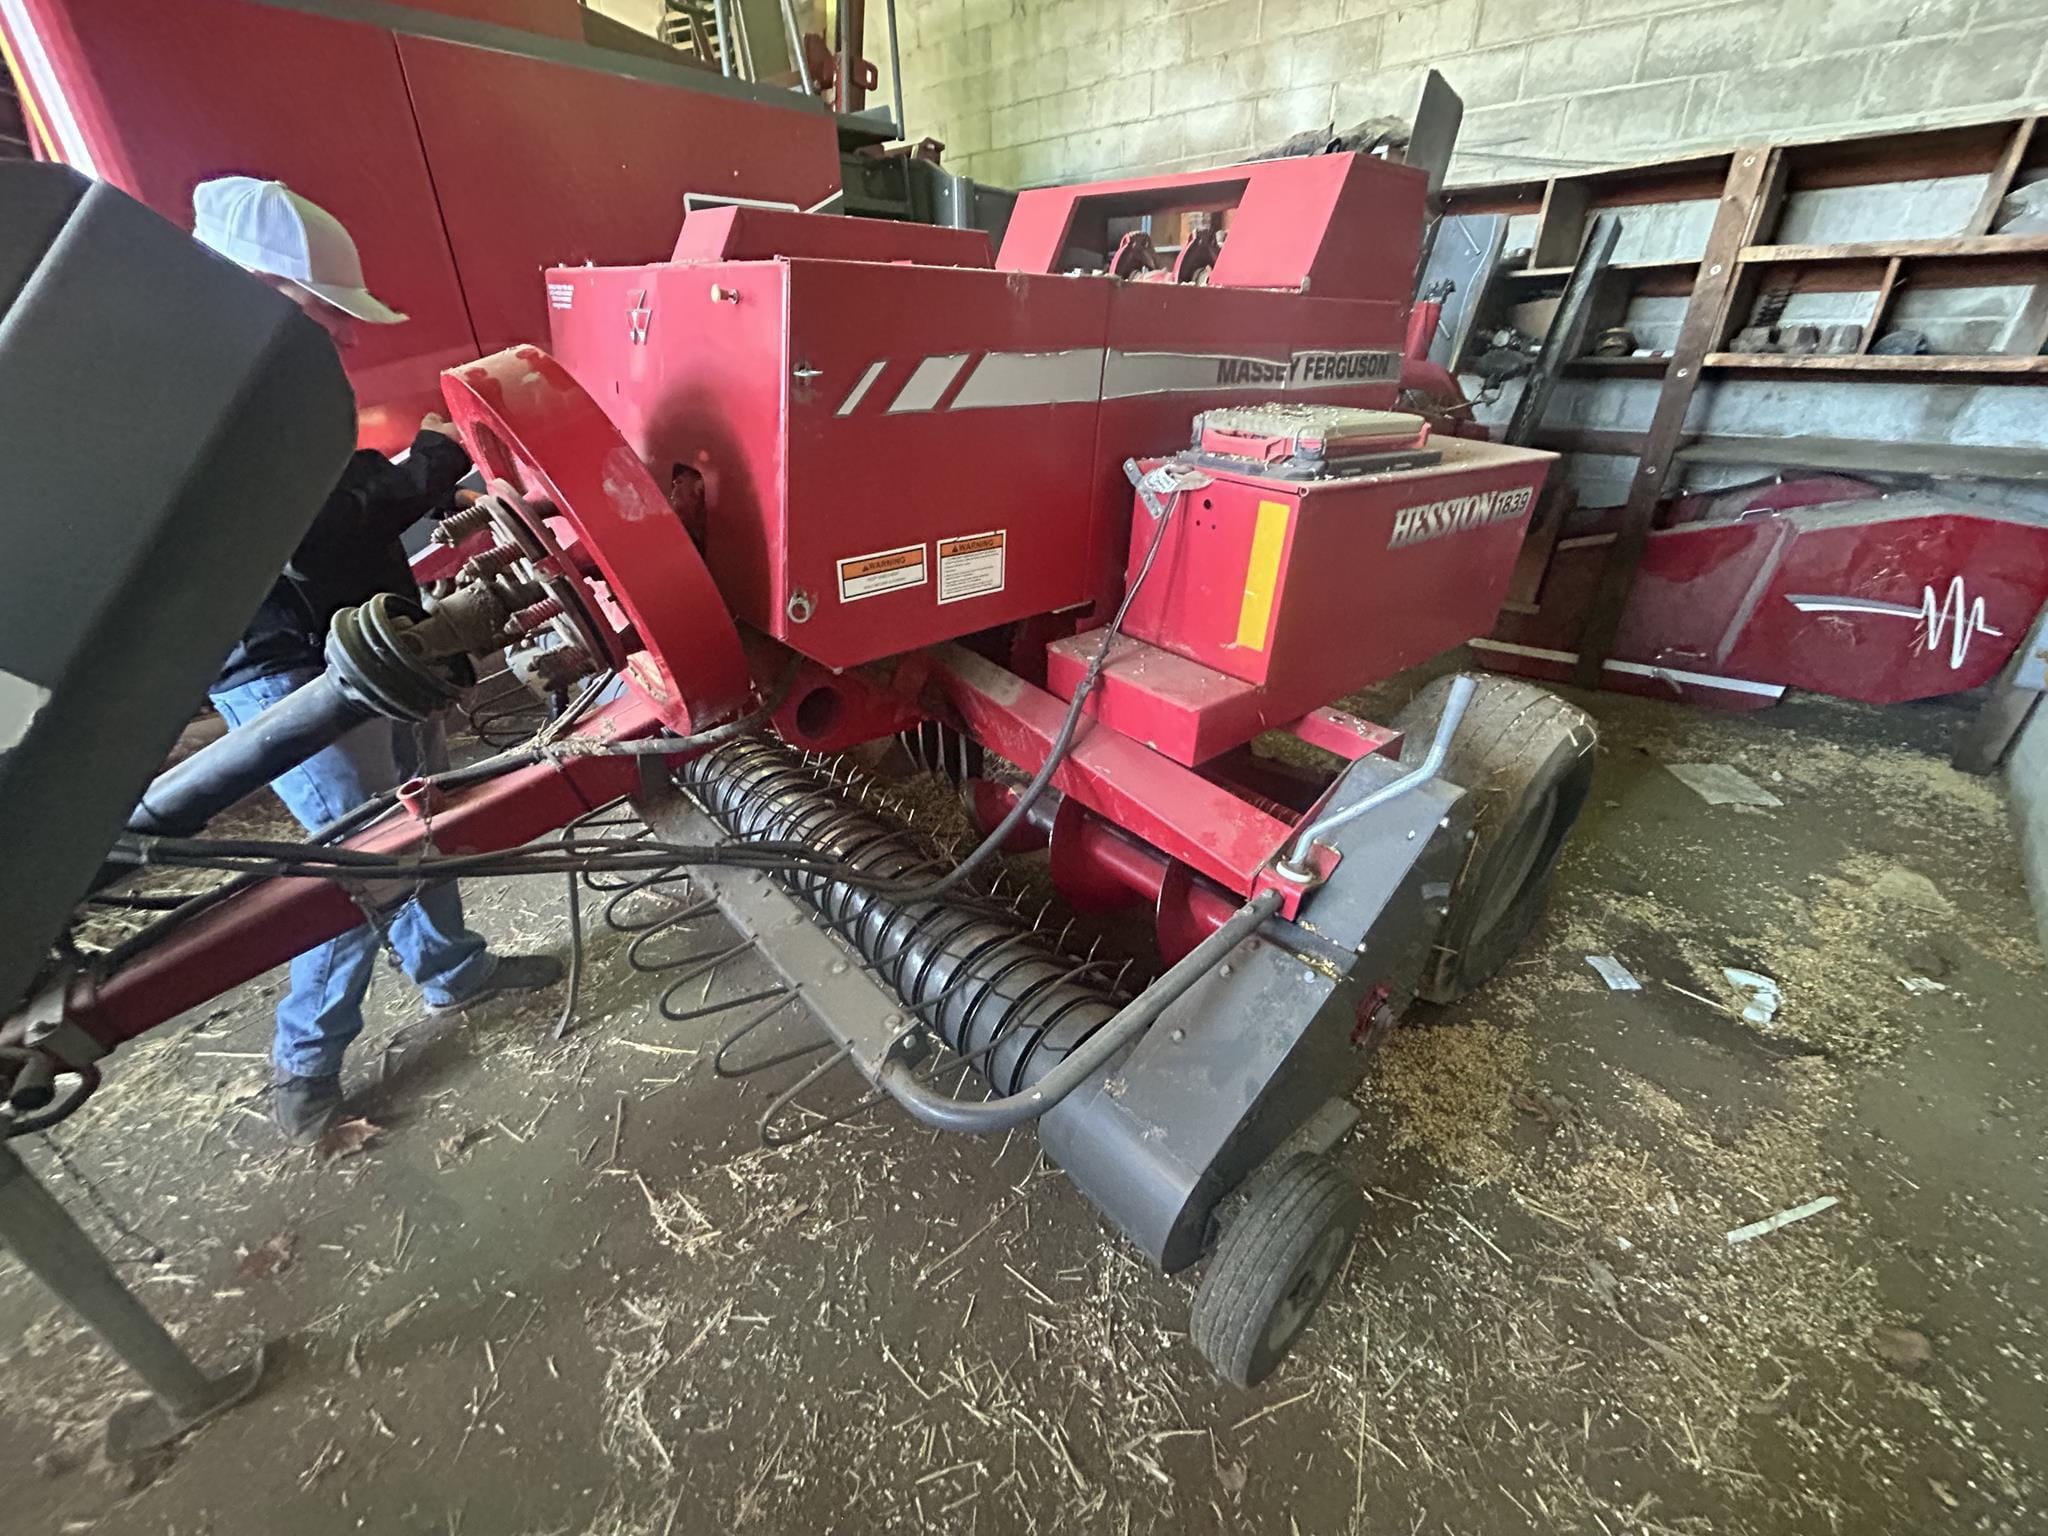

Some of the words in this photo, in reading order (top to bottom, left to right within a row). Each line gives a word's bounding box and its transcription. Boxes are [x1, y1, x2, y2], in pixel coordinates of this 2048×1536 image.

[1217, 356, 1300, 384] MASSEY
[1303, 354, 1391, 381] FERGUSON
[1387, 490, 1498, 550] HESSTON
[1496, 491, 1530, 517] 1839
[958, 538, 995, 552] WARNING
[868, 556, 906, 570] WARNING
